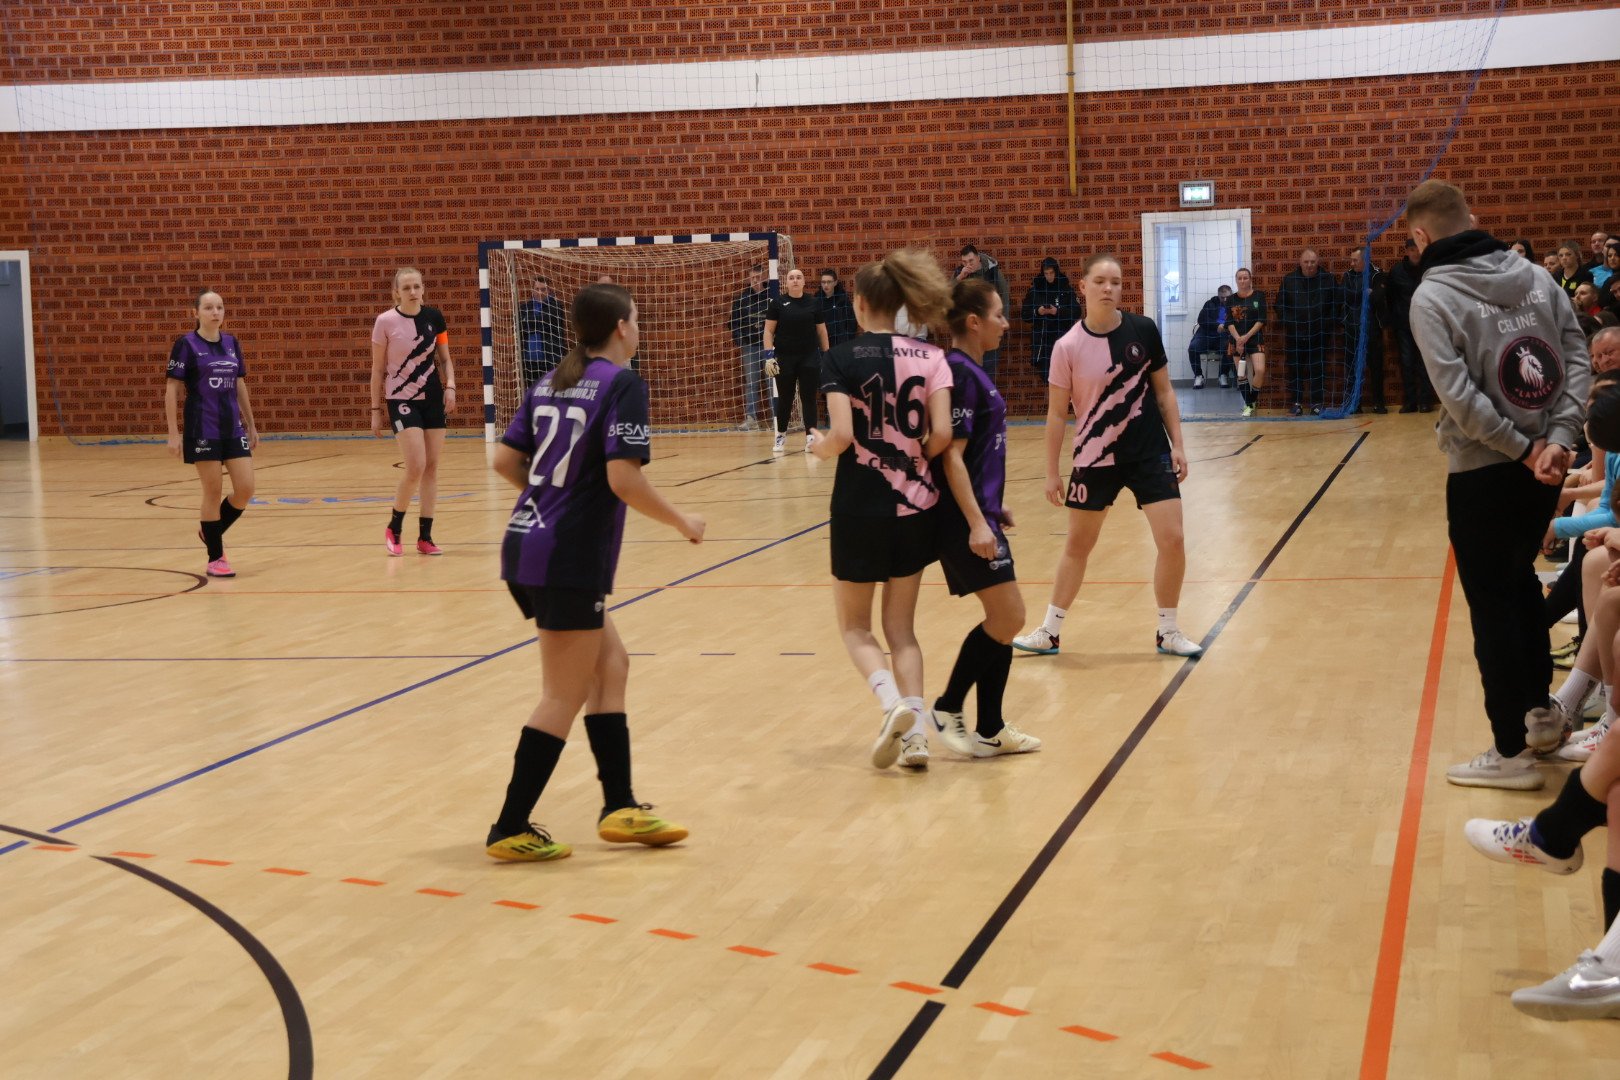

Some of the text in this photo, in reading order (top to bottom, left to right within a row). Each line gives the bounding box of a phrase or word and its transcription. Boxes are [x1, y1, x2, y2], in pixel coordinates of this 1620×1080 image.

[1498, 312, 1538, 334] CELINE
[398, 403, 411, 415] 6
[860, 372, 926, 440] 16
[528, 405, 587, 488] 27
[1068, 481, 1088, 504] 20
